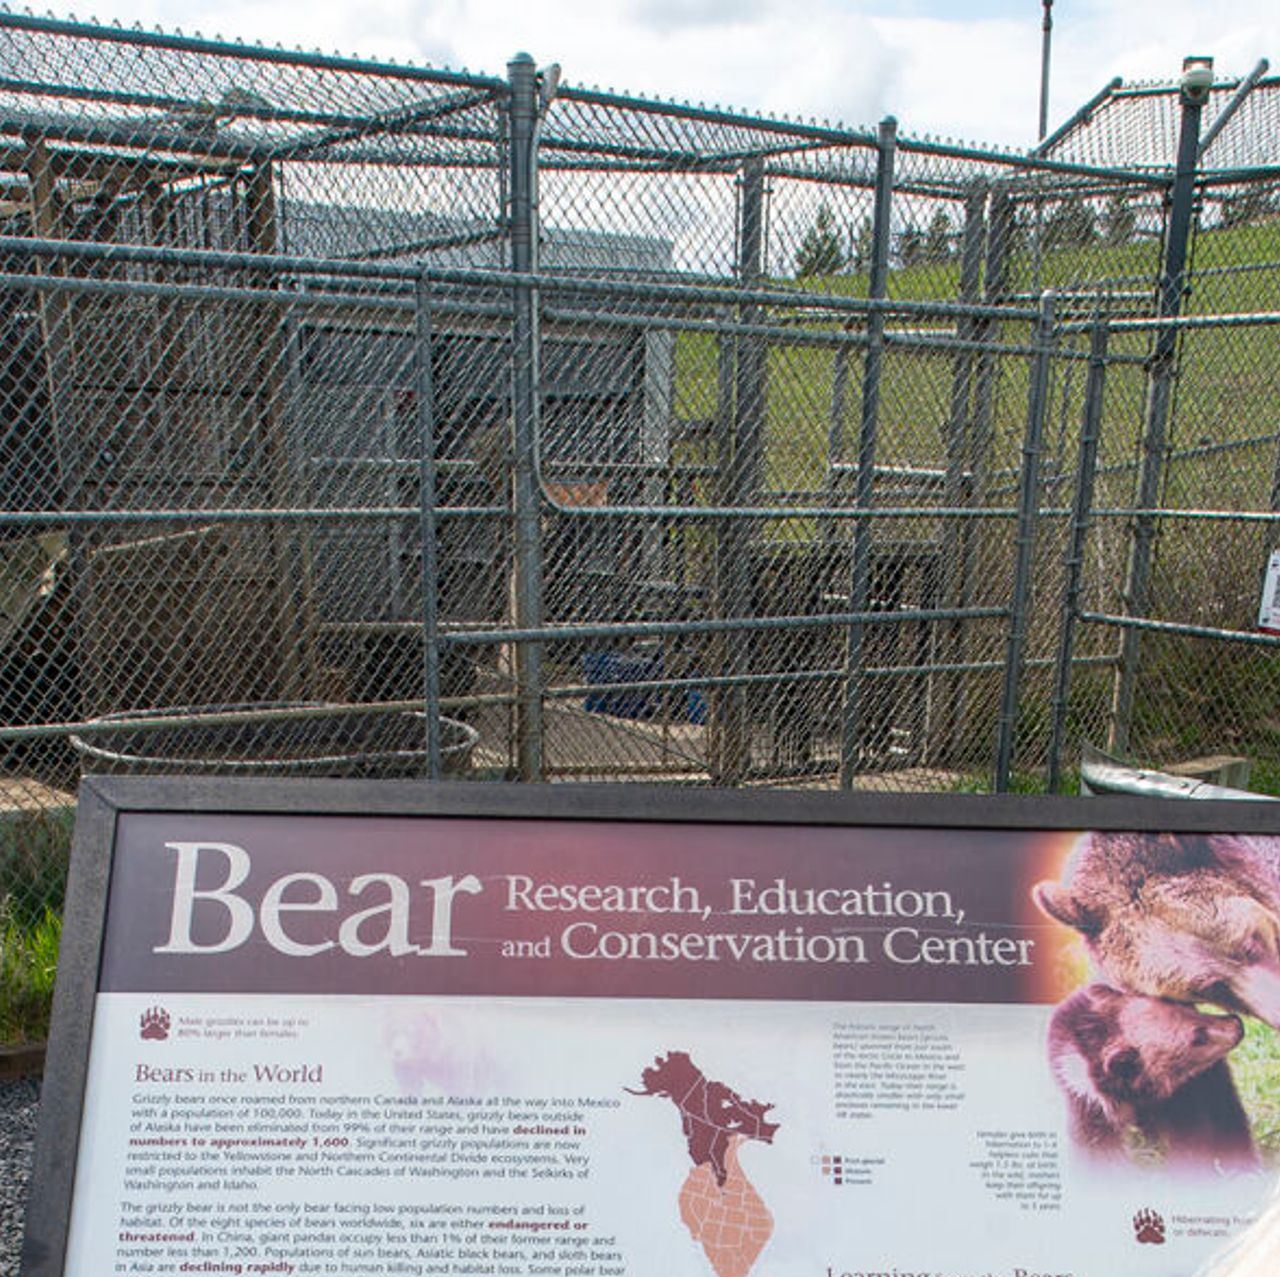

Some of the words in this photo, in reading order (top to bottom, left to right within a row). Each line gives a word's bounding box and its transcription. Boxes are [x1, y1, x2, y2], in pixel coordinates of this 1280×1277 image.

[153, 842, 483, 957] Bear
[504, 875, 713, 921] Research,
[730, 879, 966, 925] Education,
[501, 935, 551, 958] and
[560, 922, 868, 963] Conservation
[882, 926, 1036, 966] Center
[134, 1064, 194, 1082] Bears
[198, 1069, 215, 1082] in
[220, 1068, 248, 1082] the
[252, 1064, 322, 1083] World
[128, 1135, 188, 1146] numbers
[190, 1138, 207, 1147] to
[209, 1136, 308, 1151] approximately
[356, 1137, 416, 1152] Significant
[419, 1137, 457, 1153] grizzly
[460, 1138, 530, 1153] populations
[532, 1141, 551, 1149] are
[554, 1141, 581, 1149] now
